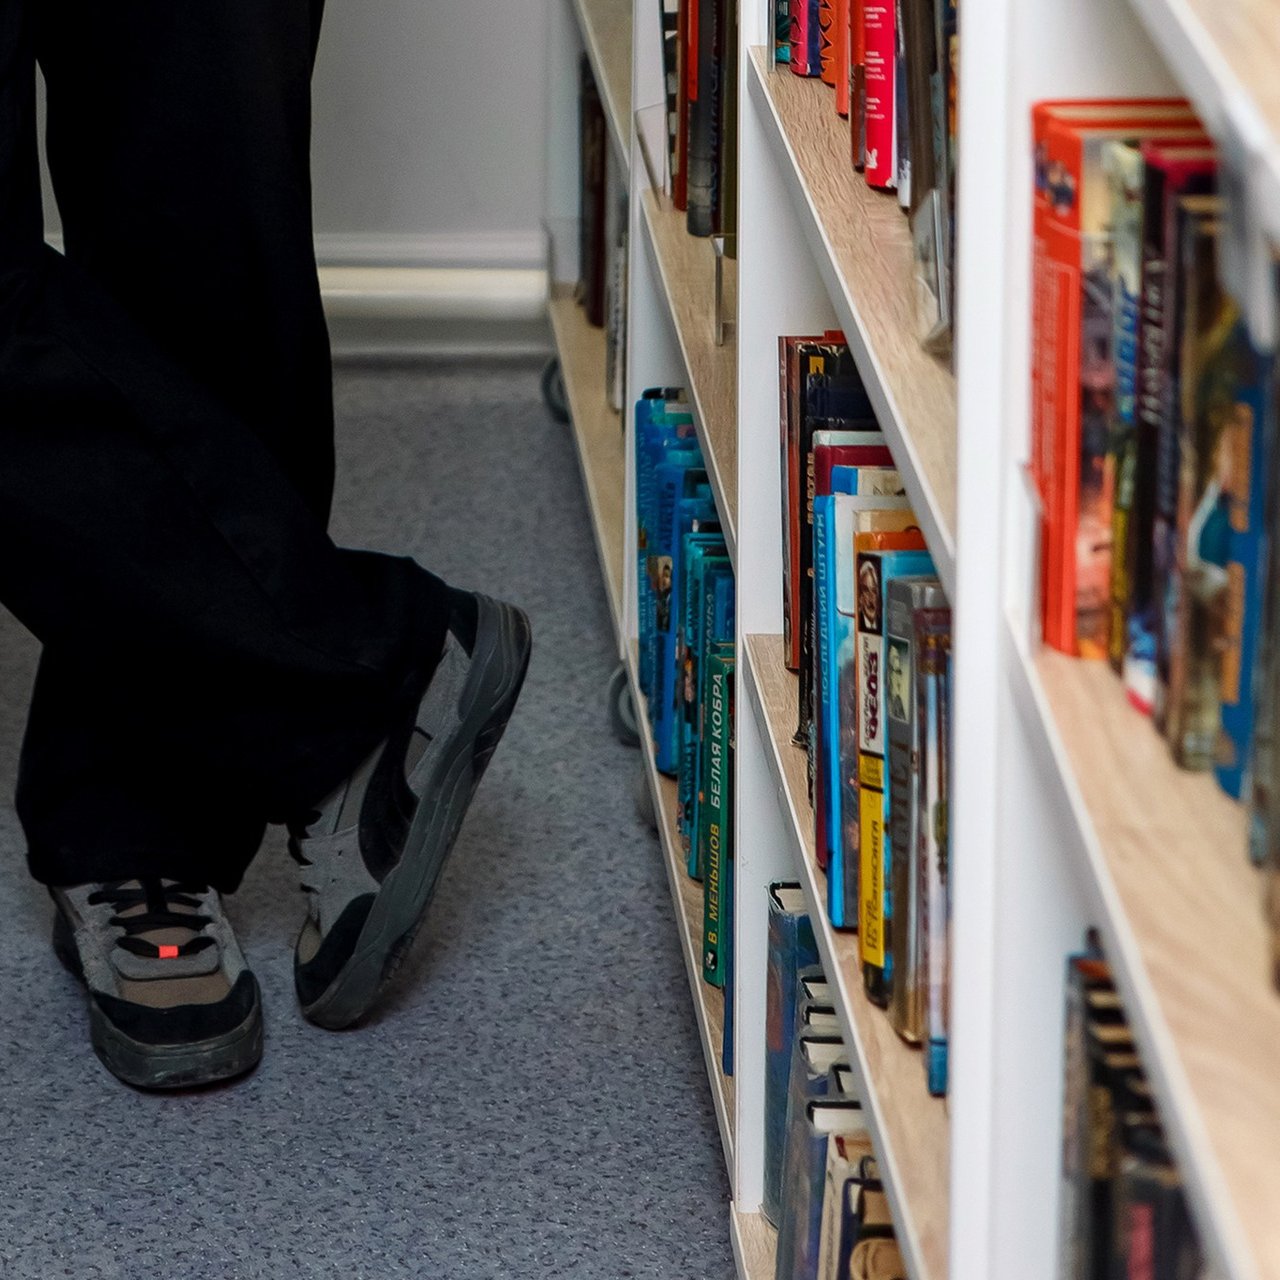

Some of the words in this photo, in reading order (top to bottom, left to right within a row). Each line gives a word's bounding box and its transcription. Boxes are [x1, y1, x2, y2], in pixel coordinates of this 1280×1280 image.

[817, 513, 827, 581] ШТУРМ
[818, 585, 830, 705] ПОСЛЕДНИЙ
[711, 672, 724, 740] КОБРА
[710, 740, 722, 810] БЕЛАЯ
[708, 823, 720, 922] МЕНЬШОВ
[707, 926, 718, 945] В.
